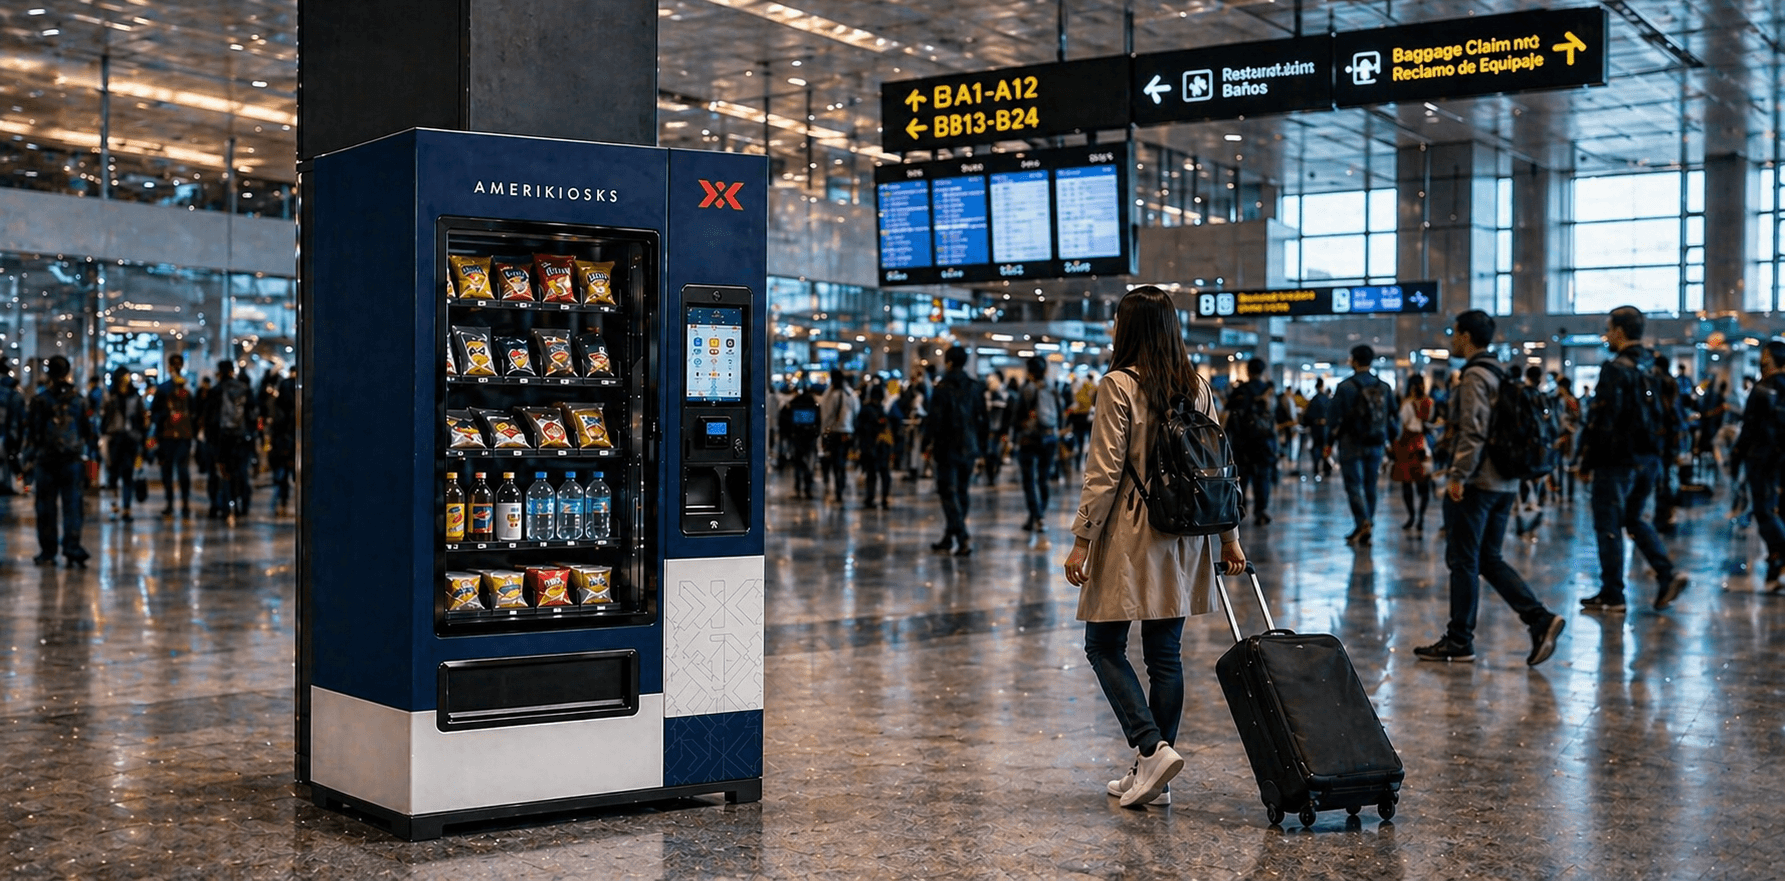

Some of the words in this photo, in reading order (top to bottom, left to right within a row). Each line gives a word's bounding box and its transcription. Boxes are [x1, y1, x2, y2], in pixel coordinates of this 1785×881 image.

[1392, 44, 1463, 65] Baggage
[1465, 37, 1511, 55] Claim
[1392, 64, 1456, 81] Reclamo
[1457, 59, 1477, 75] de
[1479, 52, 1545, 75] Equipaje
[1222, 81, 1268, 98] Baños
[933, 106, 1040, 138] BB13-B24
[474, 180, 618, 203] AMERIKIOSKS
